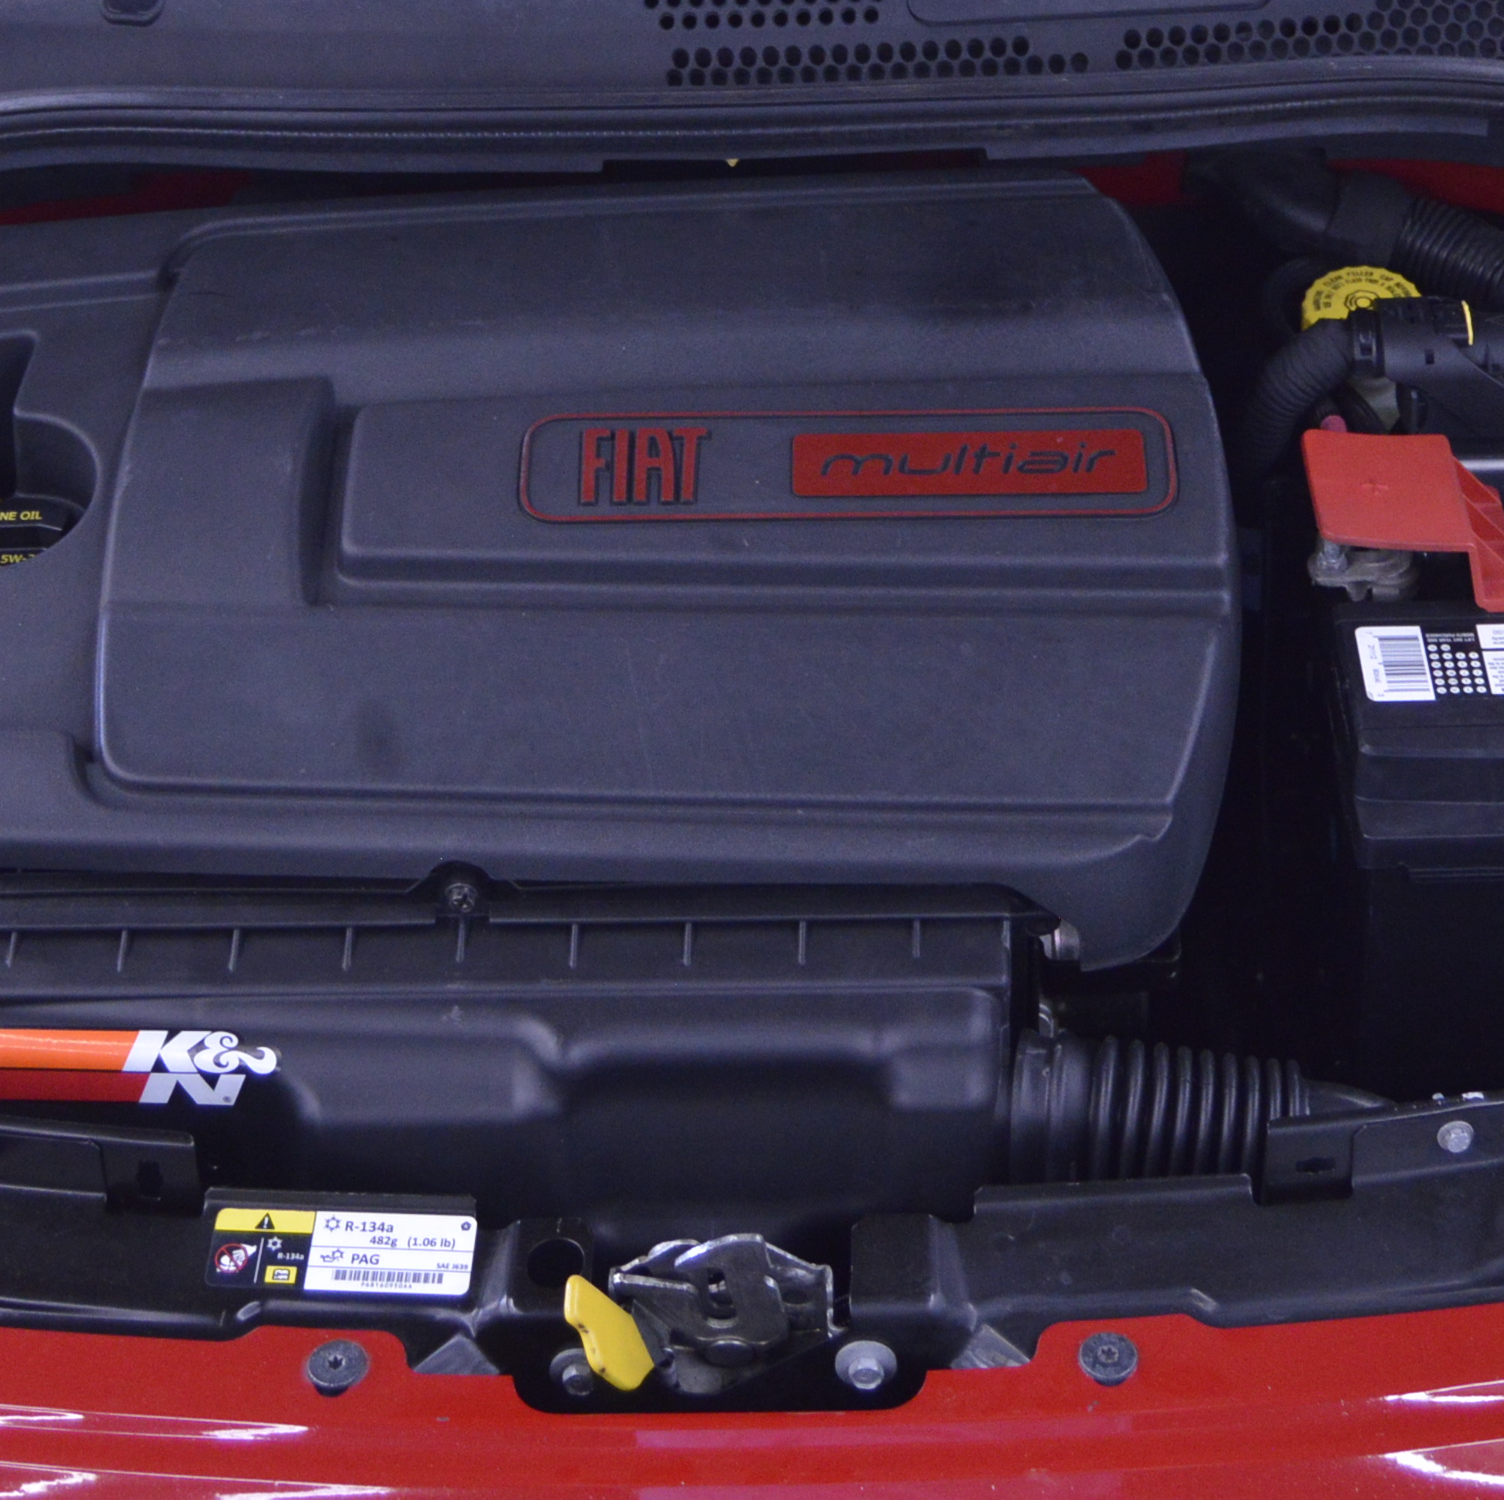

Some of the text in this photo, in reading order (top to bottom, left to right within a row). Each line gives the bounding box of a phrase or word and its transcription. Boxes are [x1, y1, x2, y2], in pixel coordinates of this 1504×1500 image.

[578, 427, 1116, 506] FIAT multiair
[19, 510, 43, 521] OIL
[344, 1220, 394, 1233] R-134a
[369, 1236, 457, 1250] 482g (1.06 lb)
[277, 1252, 304, 1261] R-134a
[350, 1253, 380, 1265] PAG
[436, 1262, 469, 1271] SAE J639
